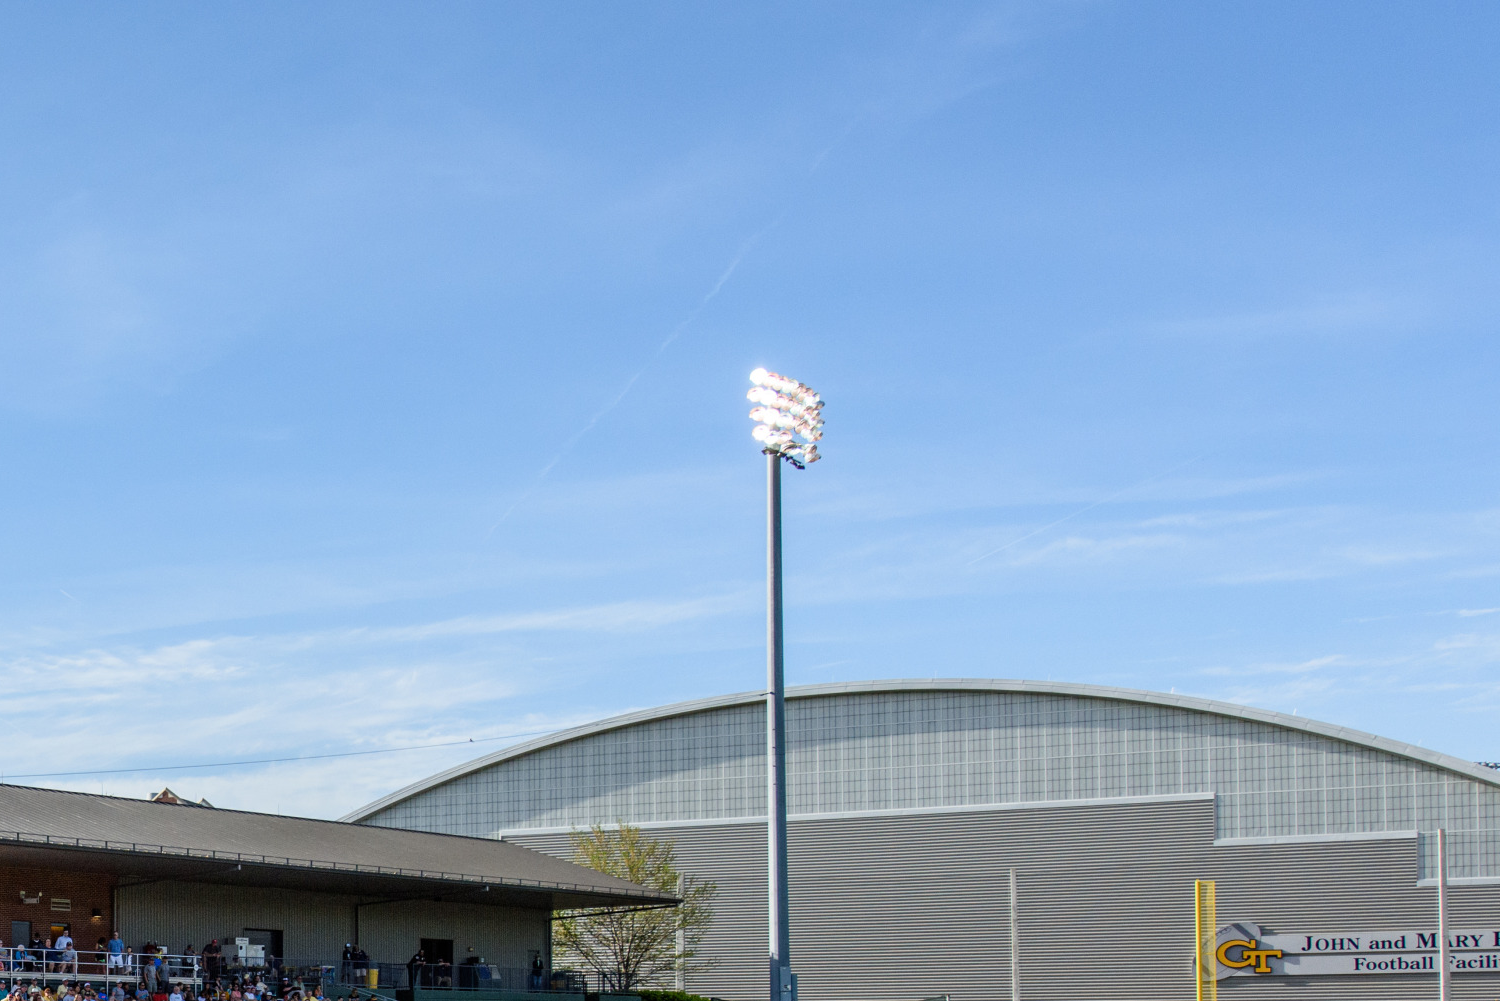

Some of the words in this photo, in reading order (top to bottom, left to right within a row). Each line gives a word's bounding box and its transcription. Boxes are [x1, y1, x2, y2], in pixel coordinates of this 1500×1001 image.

[1301, 936, 1360, 951] JOHN
[1369, 936, 1406, 949] and
[1216, 939, 1283, 973] GT
[1353, 956, 1434, 970] Football
[1449, 954, 1500, 969] acili
